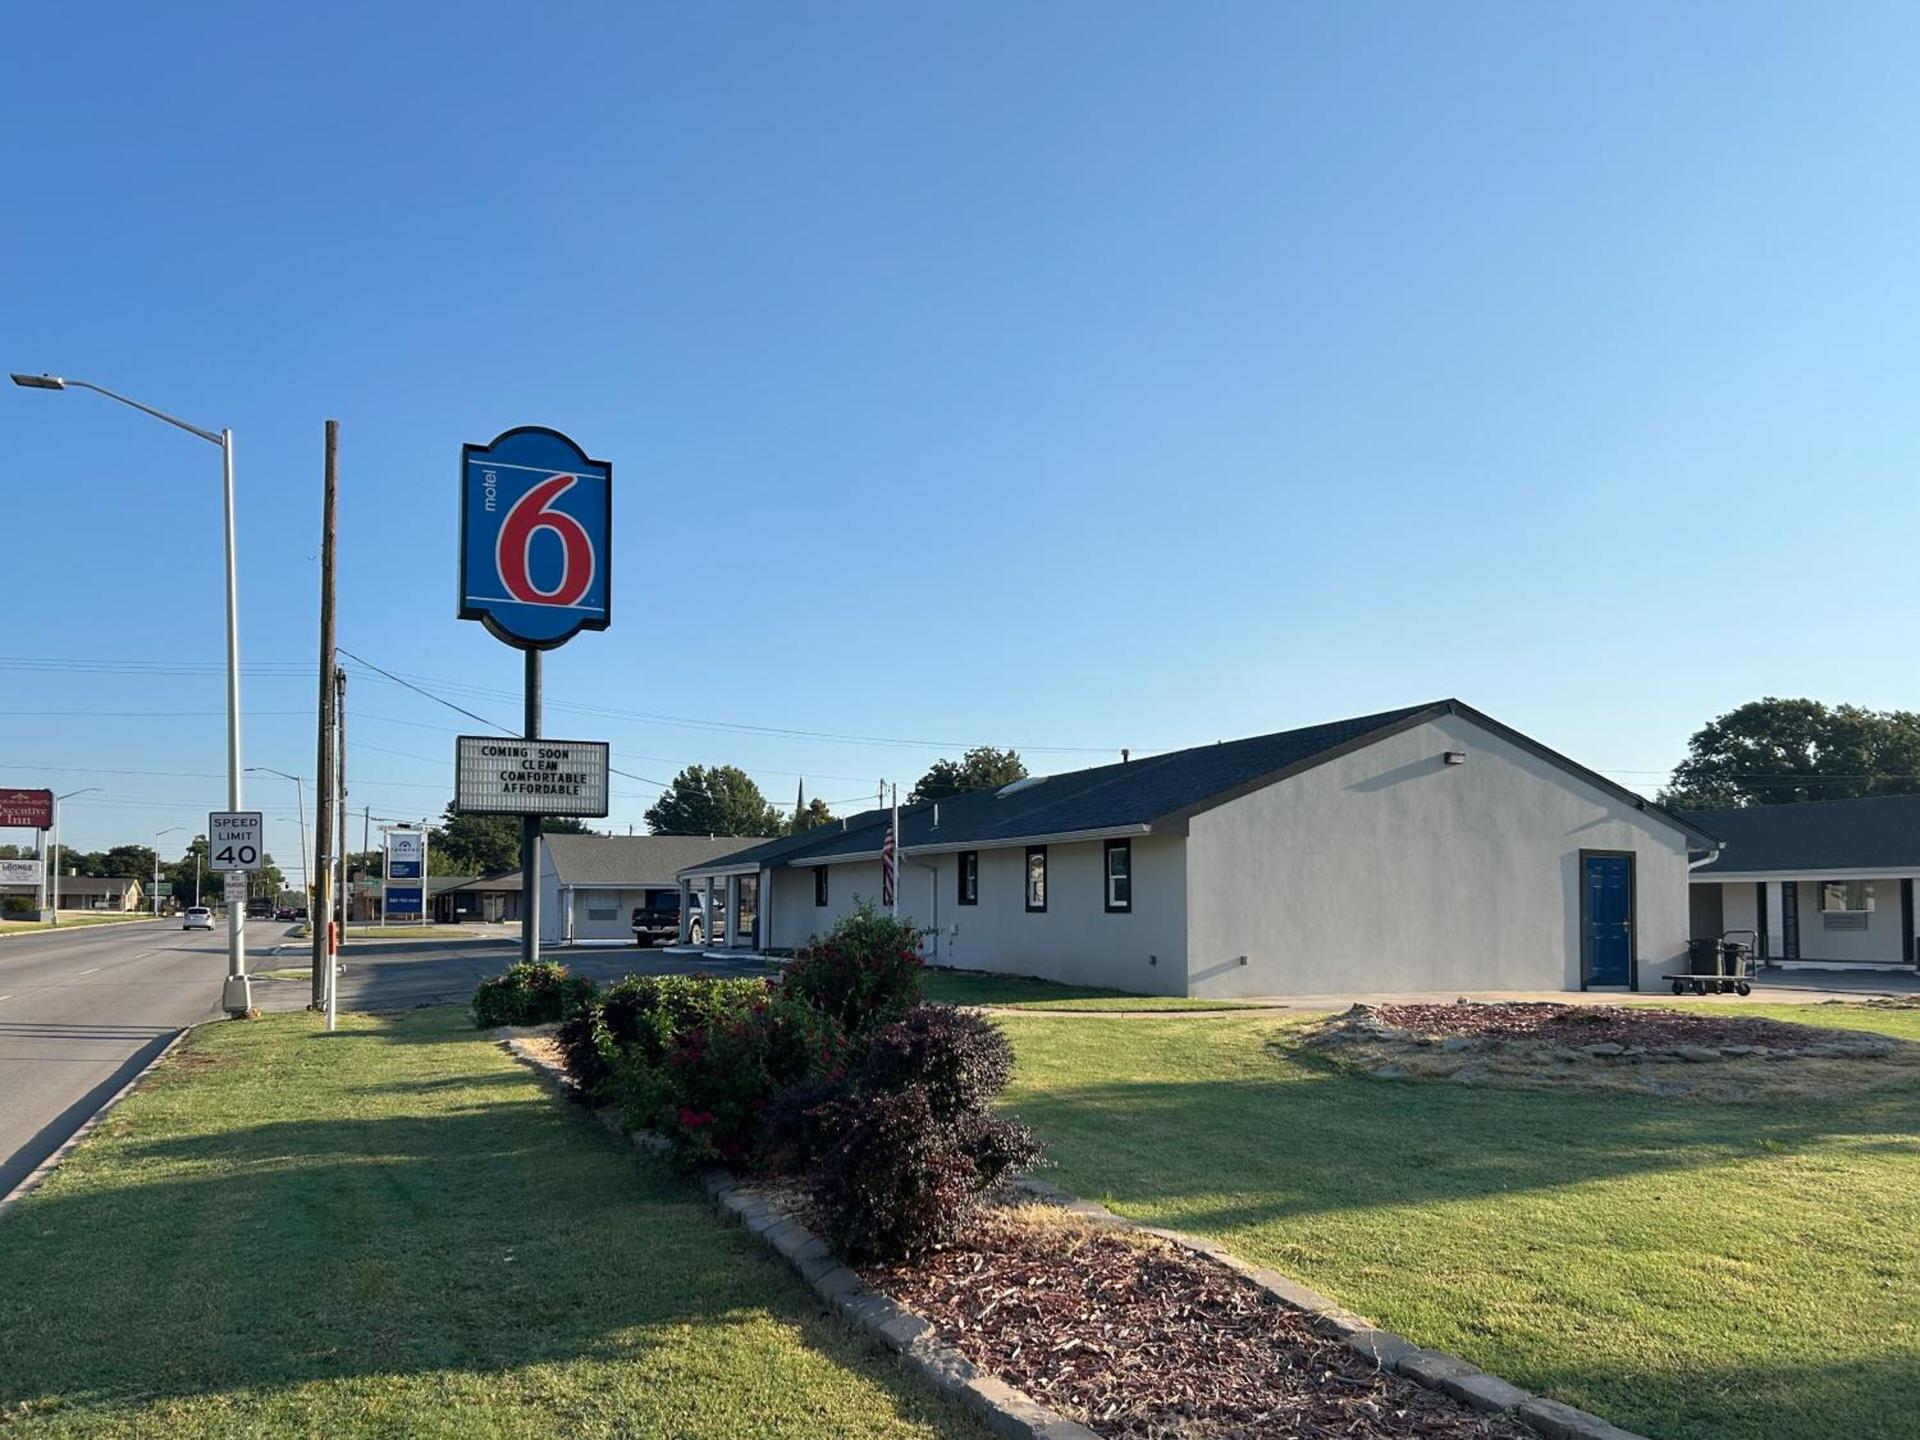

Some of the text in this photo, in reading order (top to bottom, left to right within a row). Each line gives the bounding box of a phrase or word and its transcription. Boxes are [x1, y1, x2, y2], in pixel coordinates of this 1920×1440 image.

[482, 469, 496, 512] motel
[495, 473, 596, 607] 6
[481, 745, 569, 759] COMING SOON
[522, 759, 558, 771] CLEAN
[500, 770, 587, 784] COMFORTABLE
[503, 783, 580, 795] AFFORDABLE
[7, 814, 31, 825] Inn
[214, 818, 258, 827] SPEED
[218, 831, 253, 841] LIMIT
[215, 845, 257, 864] 40
